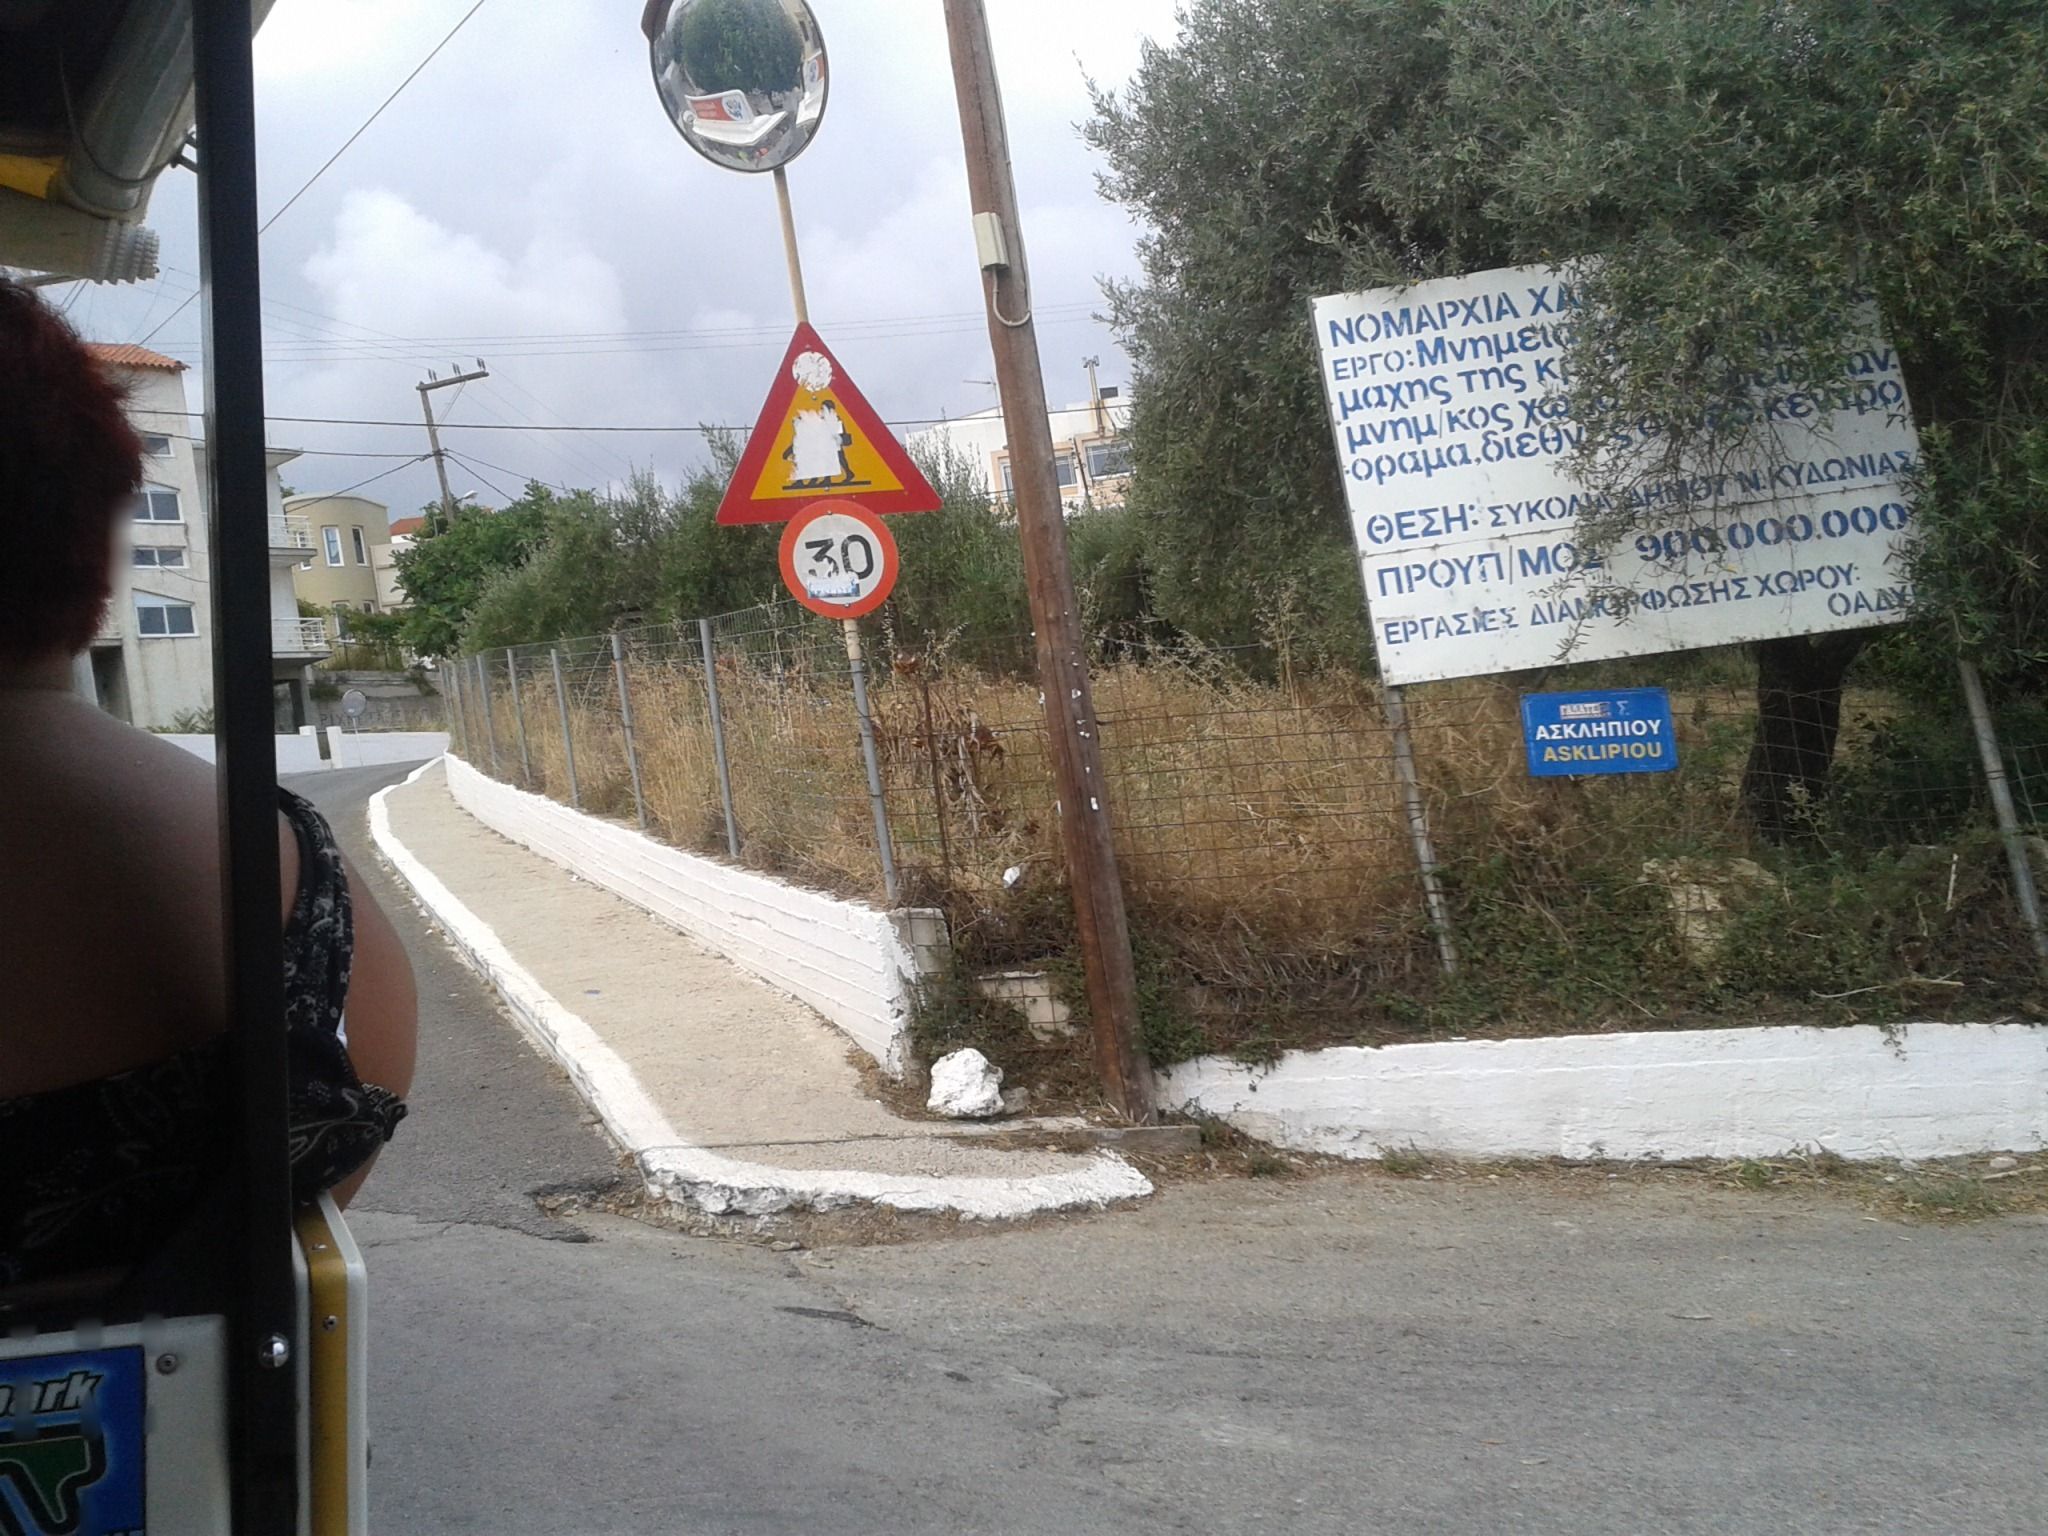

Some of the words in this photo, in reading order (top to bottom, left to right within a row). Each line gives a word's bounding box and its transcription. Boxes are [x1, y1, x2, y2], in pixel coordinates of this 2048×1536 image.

[1329, 291, 1520, 347] ΝΟΜΑΡΧΙΑ
[1457, 363, 1527, 393] της
[1366, 503, 1480, 545] ΘΕΣΗ:
[805, 534, 874, 580] 30
[1535, 719, 1662, 741] ΑΣΚΛΗΠΙΟΥ
[1543, 742, 1663, 763] ASKLIPIOU
